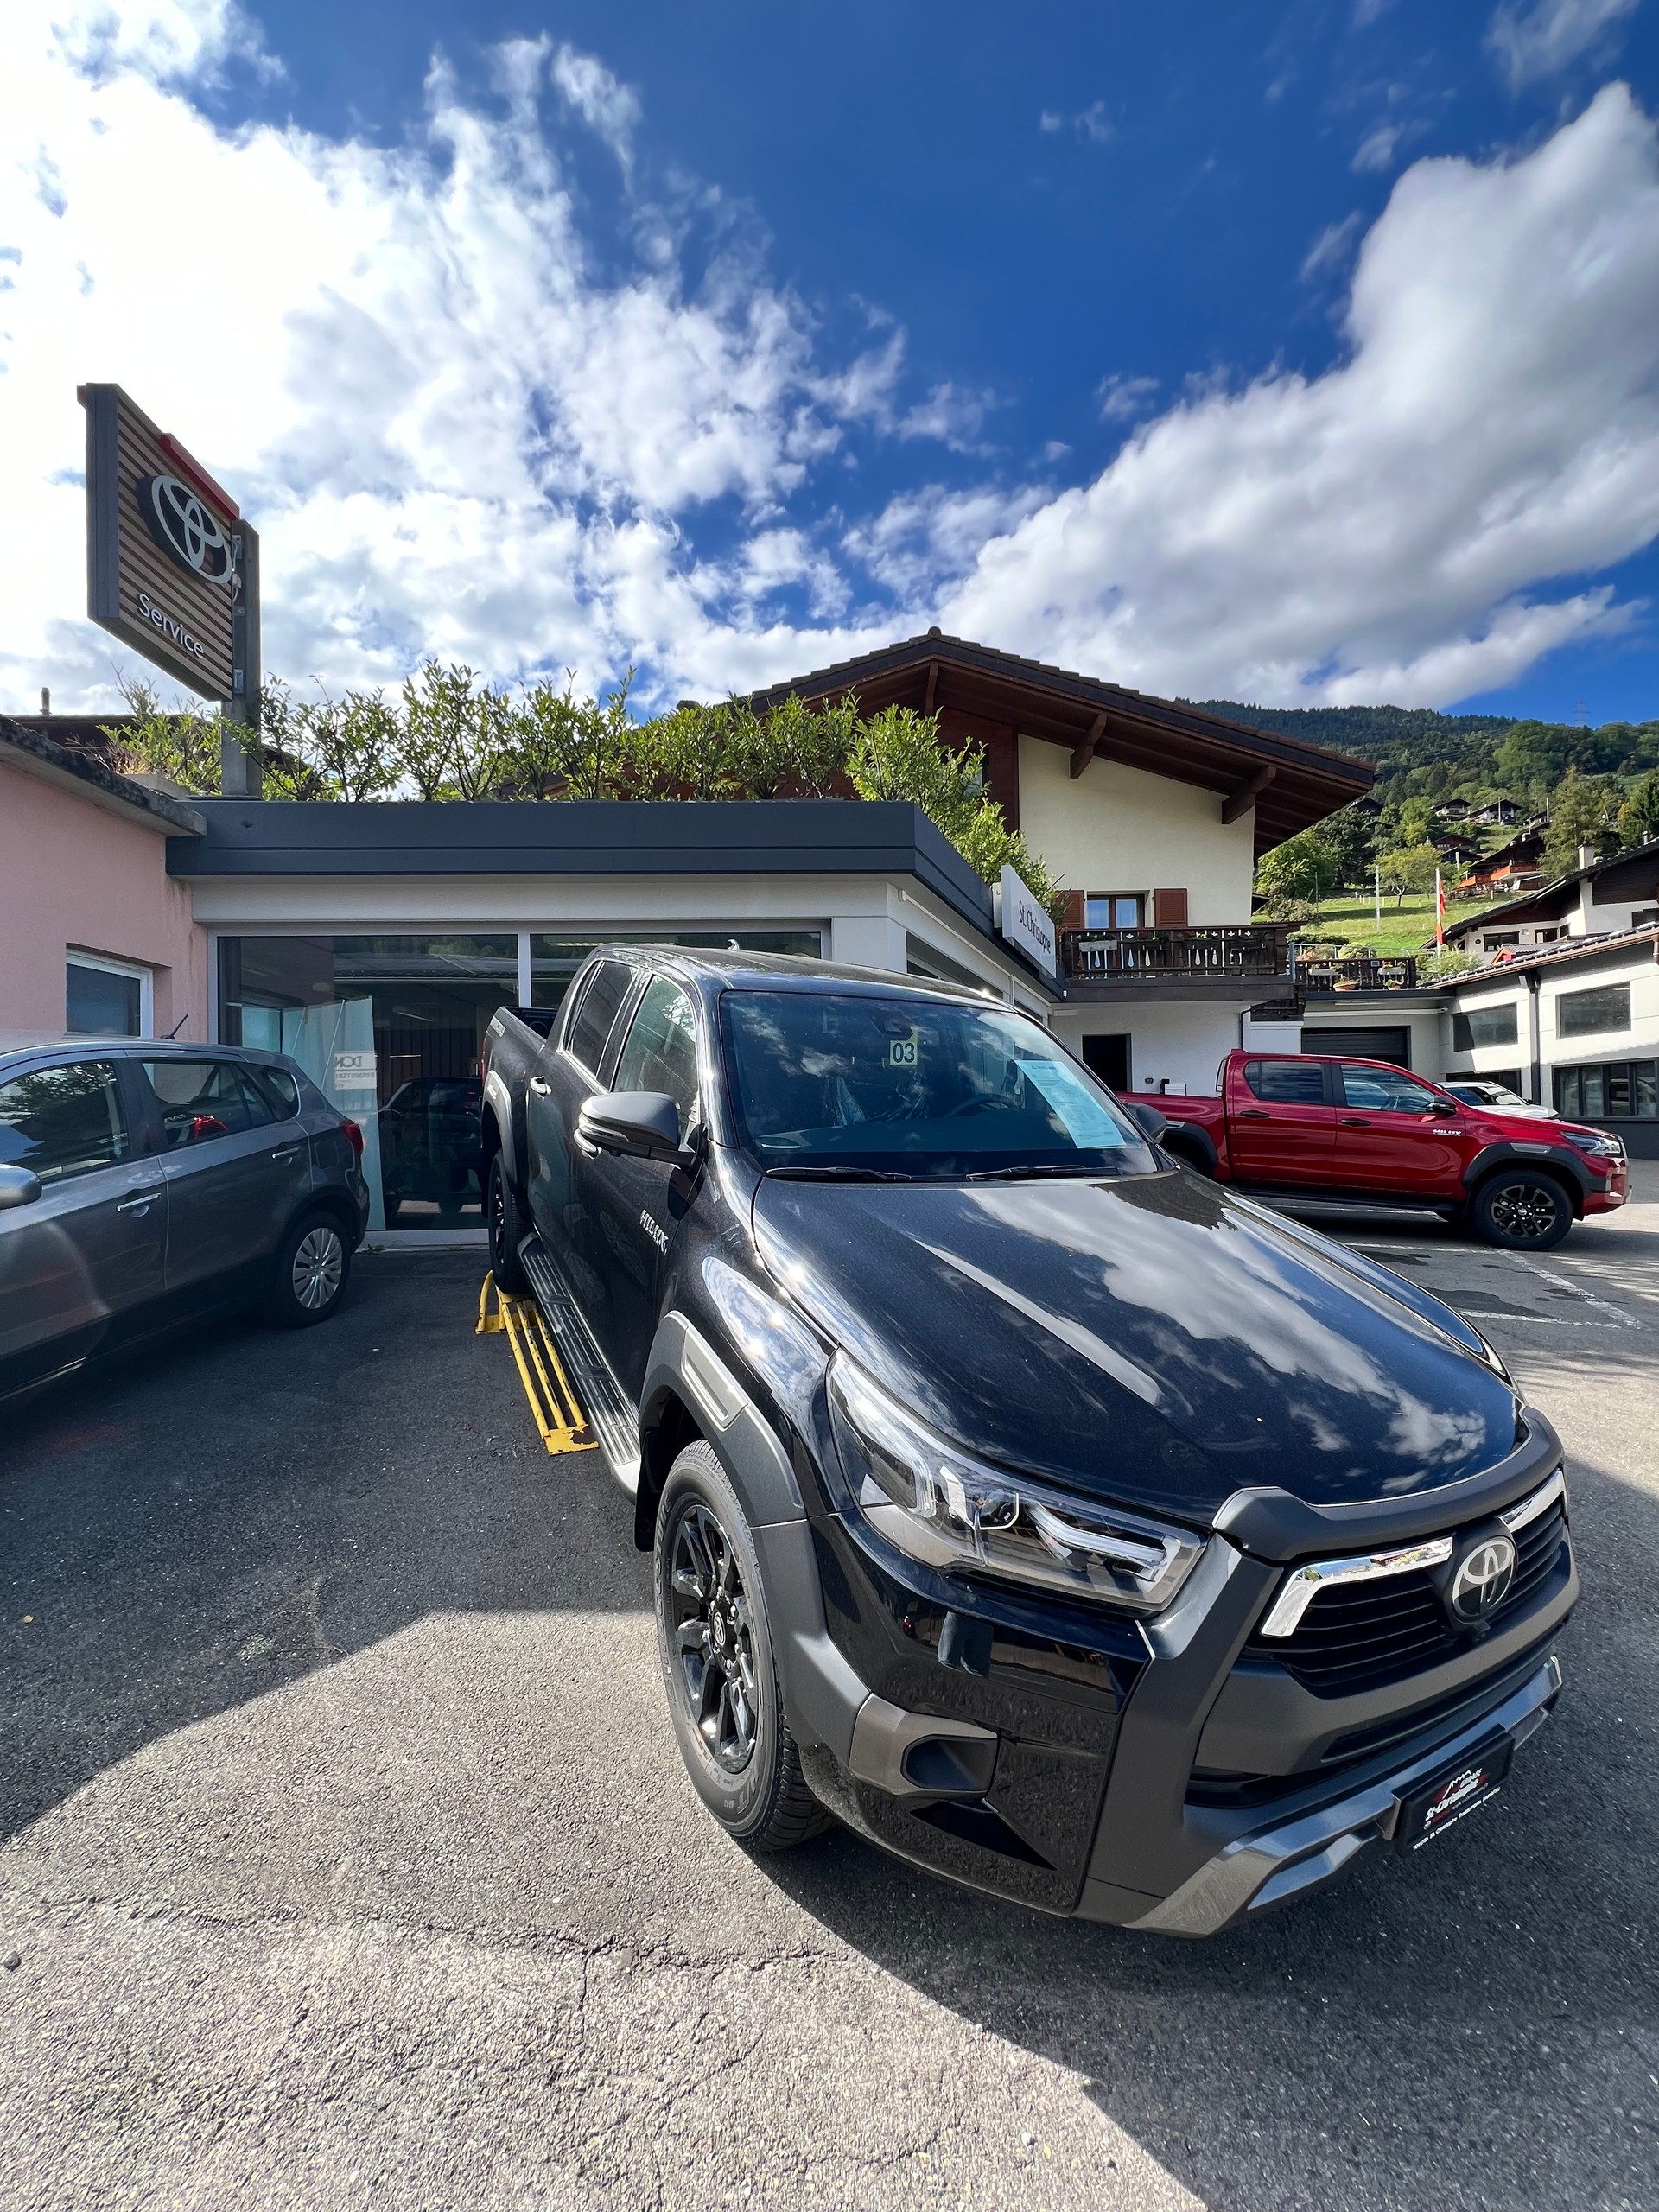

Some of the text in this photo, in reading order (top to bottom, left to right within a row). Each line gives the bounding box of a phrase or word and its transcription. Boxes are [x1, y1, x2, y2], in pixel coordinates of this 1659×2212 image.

[138, 593, 204, 659] Service
[1027, 910, 1051, 954] Christophe
[893, 1042, 915, 1063] 03
[639, 1209, 669, 1255] HILUX
